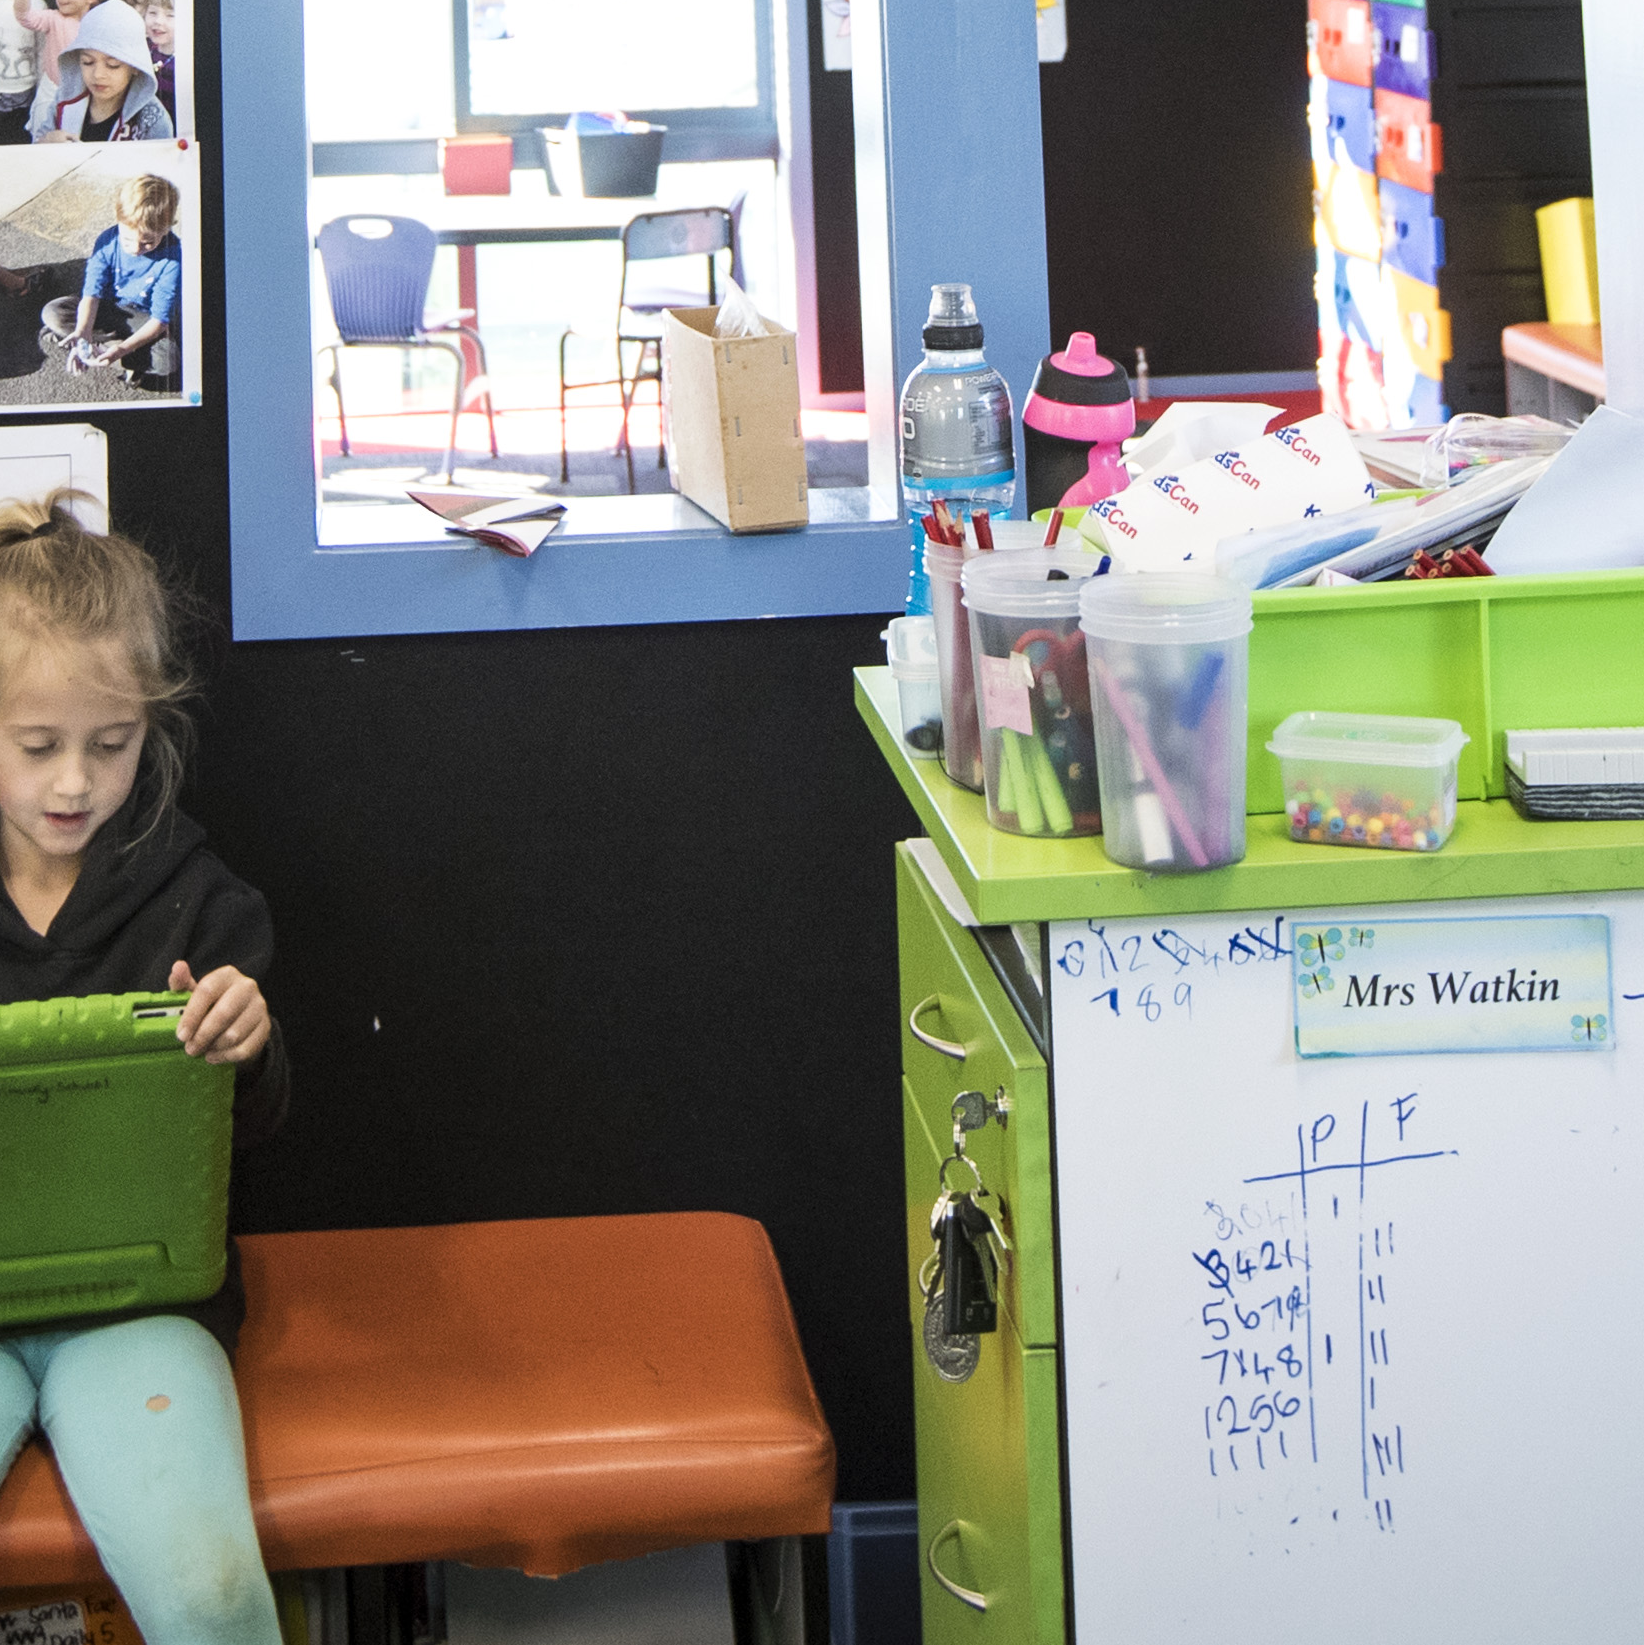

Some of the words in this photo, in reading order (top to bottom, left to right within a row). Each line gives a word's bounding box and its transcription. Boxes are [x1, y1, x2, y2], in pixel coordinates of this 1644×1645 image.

[1274, 427, 1322, 467] dsCan
[1214, 450, 1261, 490] dsCan
[1153, 475, 1200, 515] dsCan
[1344, 975, 1414, 1007] Mrs
[1428, 969, 1559, 1004] Watkin
[1388, 1093, 1419, 1142] F
